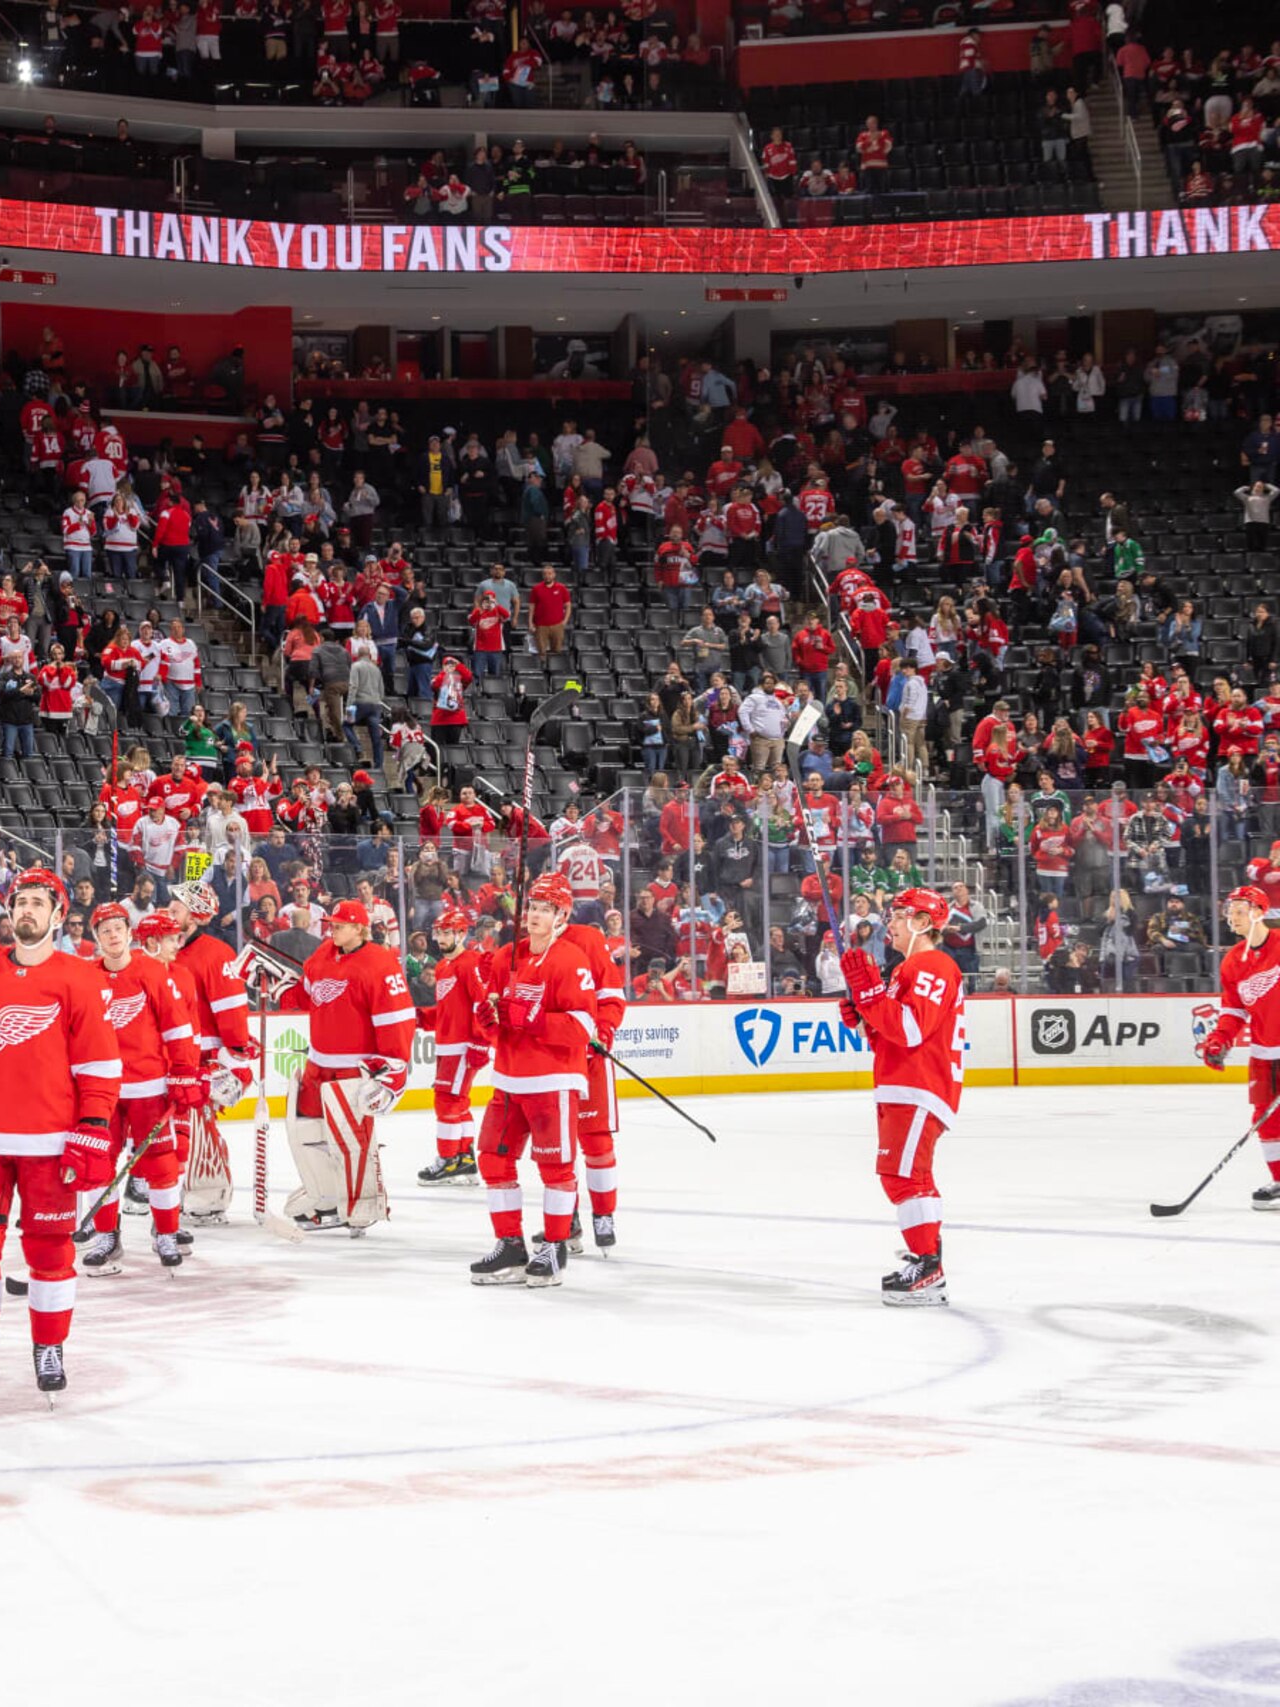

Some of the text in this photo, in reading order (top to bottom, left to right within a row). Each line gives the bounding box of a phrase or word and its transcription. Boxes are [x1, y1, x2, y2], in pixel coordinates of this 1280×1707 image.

[95, 207, 254, 266] THANK
[270, 222, 362, 270] YOU
[383, 225, 511, 271] FANS
[1084, 204, 1271, 260] THANK
[572, 860, 597, 882] 24
[385, 974, 407, 995] 35
[914, 971, 947, 1006] 52
[645, 1024, 680, 1044] savings
